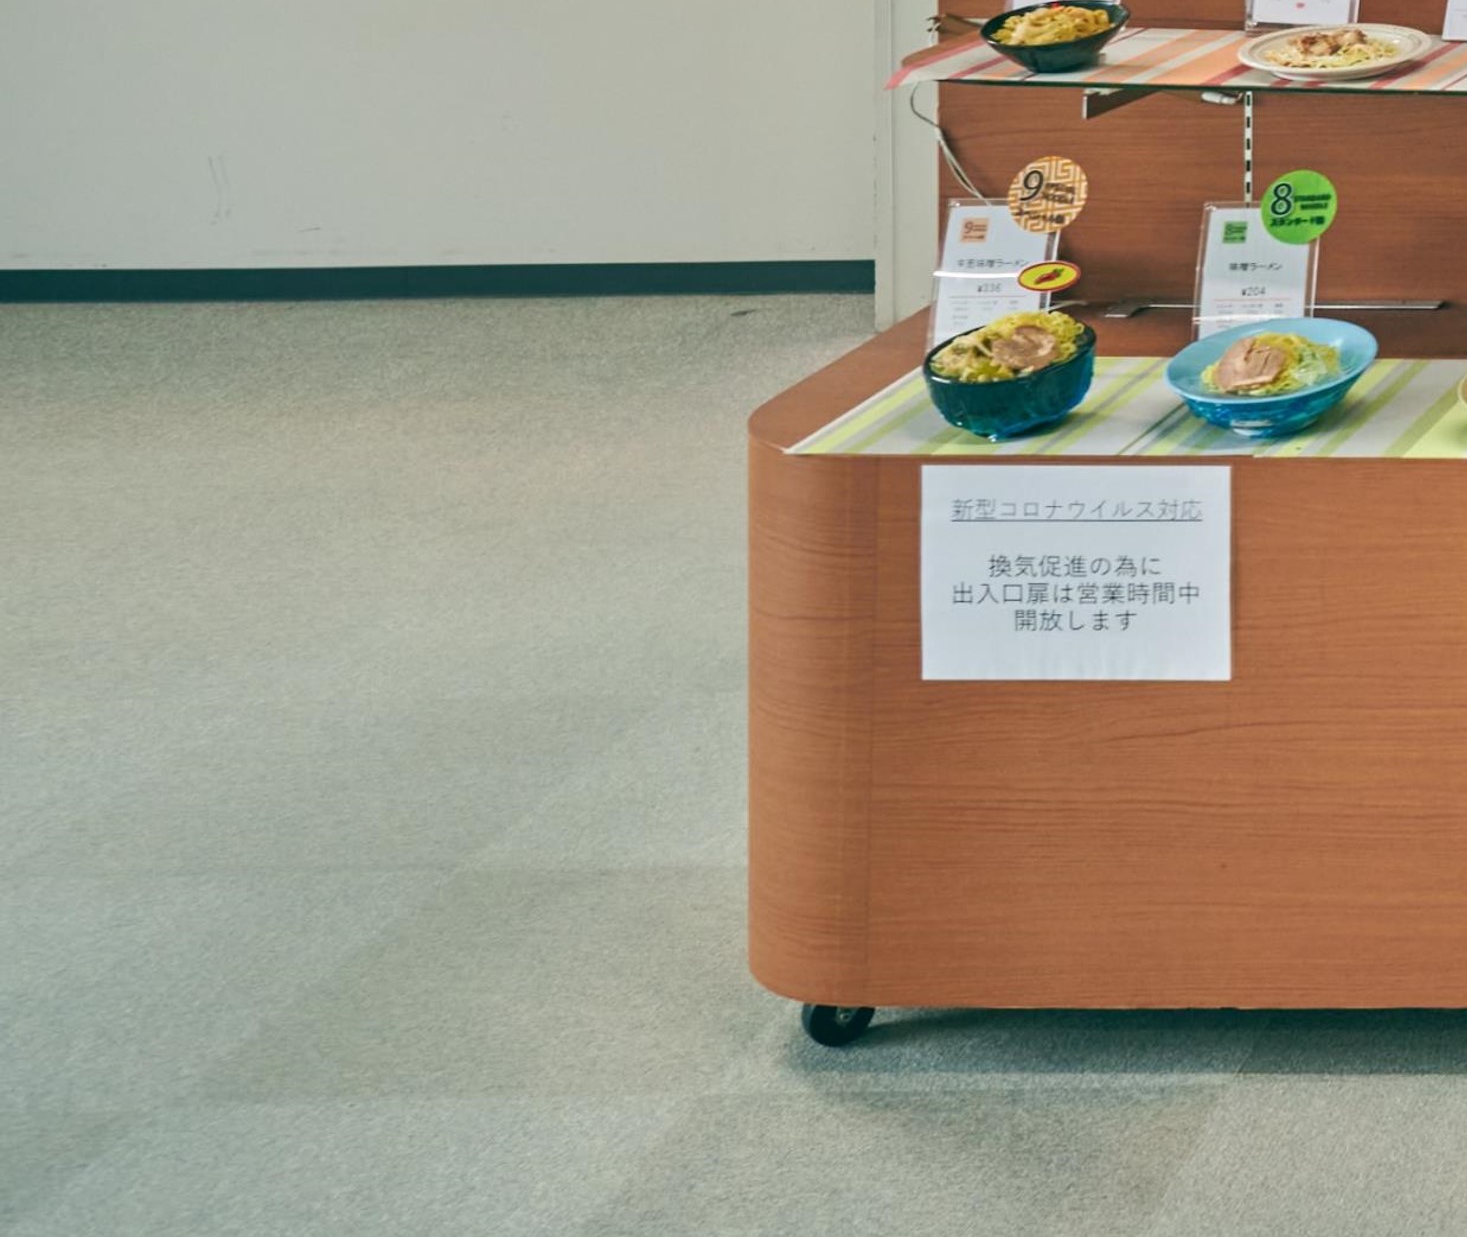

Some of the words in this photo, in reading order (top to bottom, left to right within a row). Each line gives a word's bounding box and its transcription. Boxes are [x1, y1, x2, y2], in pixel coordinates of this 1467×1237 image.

[1019, 169, 1044, 202] 9
[1271, 182, 1293, 216] 8
[950, 498, 1203, 521] 新型コロナウイルス対応
[987, 554, 1162, 578] 換気促進の為に
[951, 581, 1200, 605] 出入口扉は営業時間中
[1013, 608, 1138, 632] 開放します
